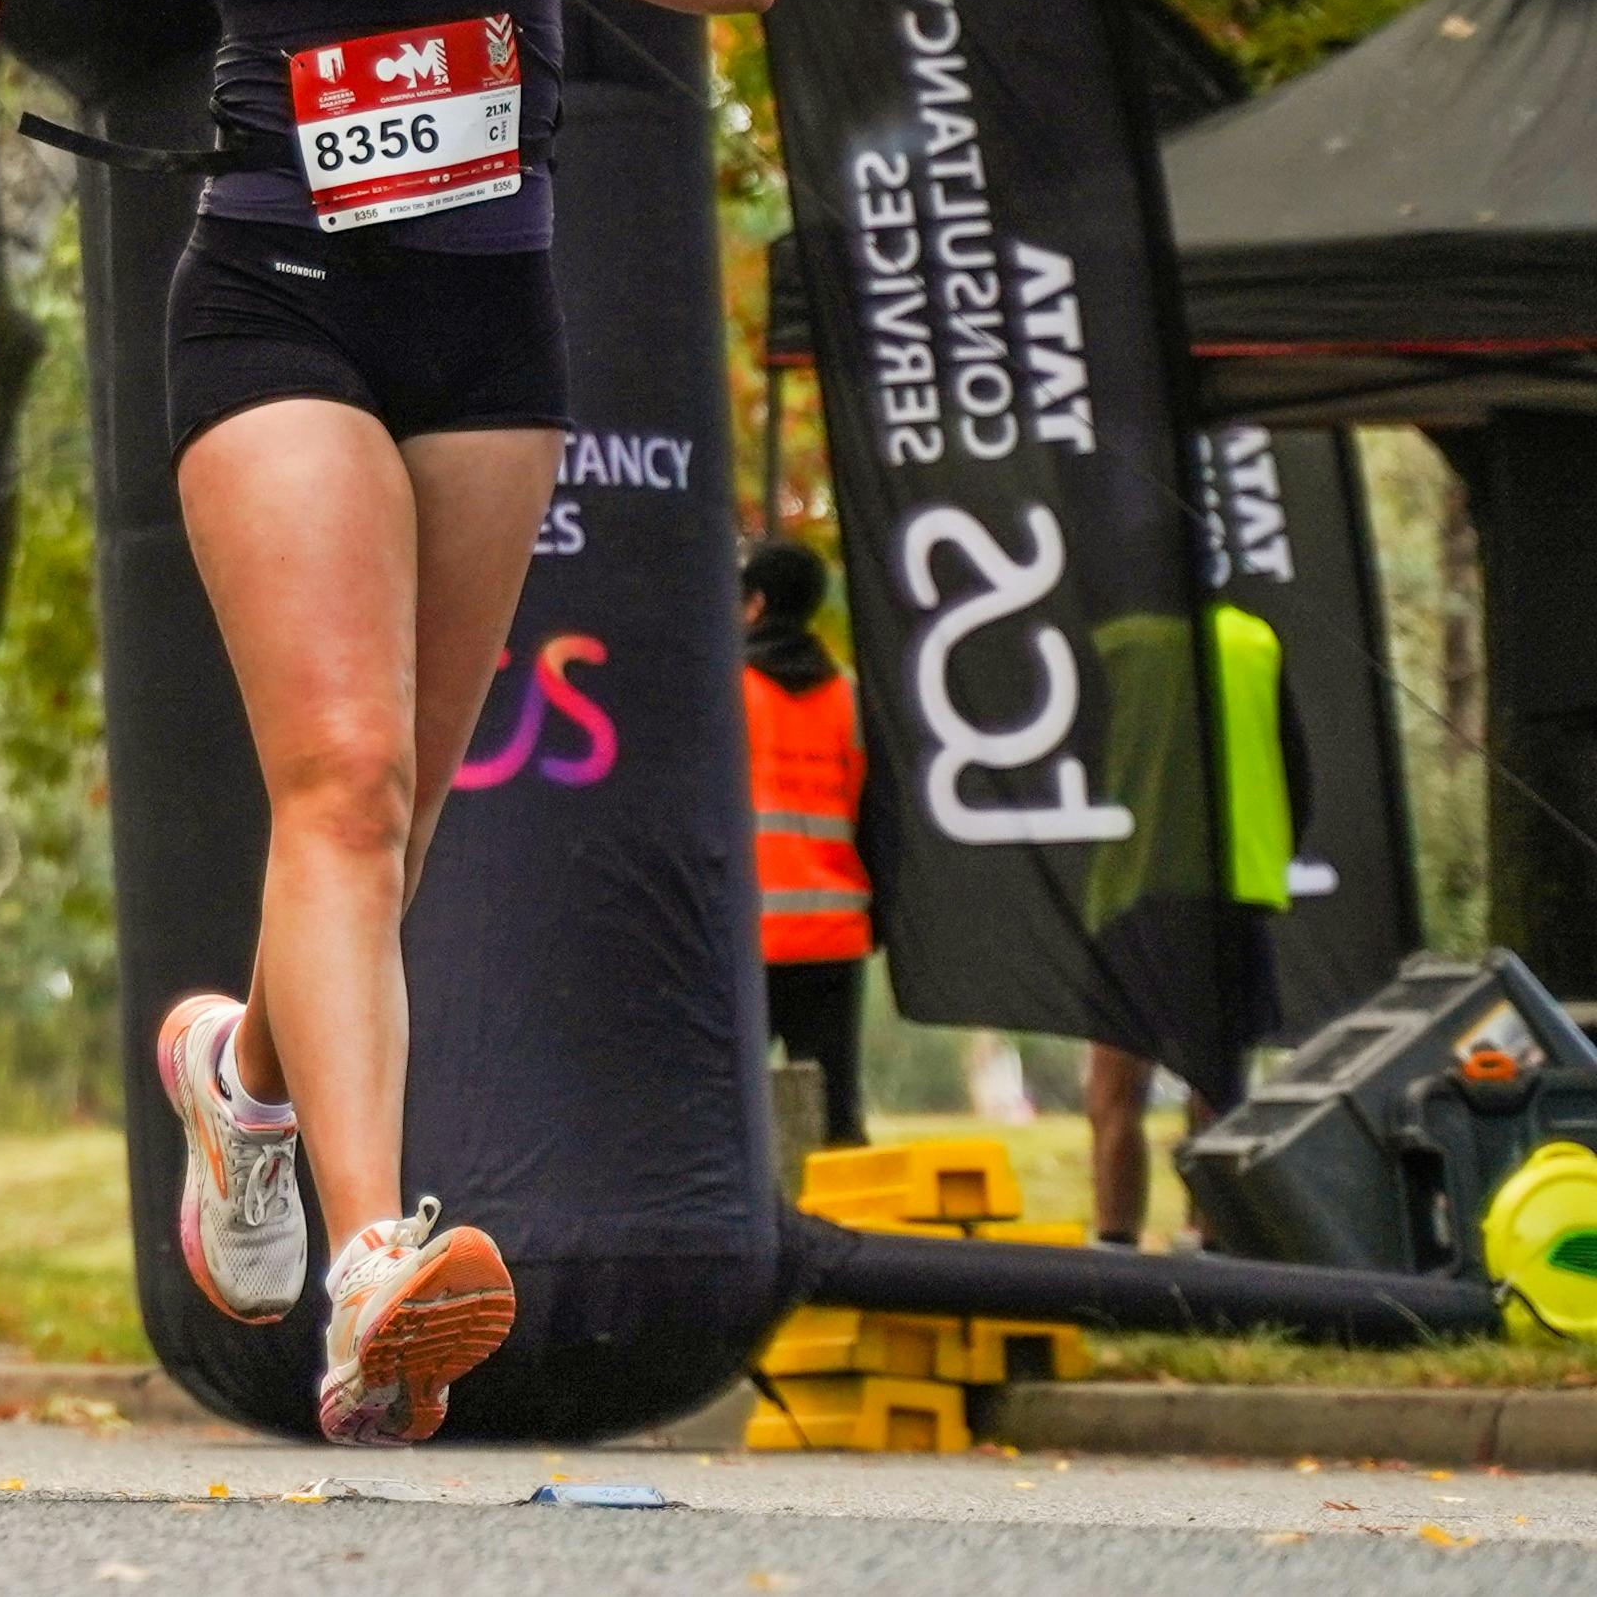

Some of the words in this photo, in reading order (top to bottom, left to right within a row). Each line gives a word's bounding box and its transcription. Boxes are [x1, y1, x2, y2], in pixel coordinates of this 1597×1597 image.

[434, 75, 450, 86] 24
[485, 101, 511, 118] 21.1K
[315, 113, 440, 172] 8356
[489, 126, 499, 141] C
[354, 208, 379, 222] 8356
[492, 180, 513, 193] 8356
[275, 262, 327, 281] SECONDLEFT
[557, 434, 693, 491] TANCY
